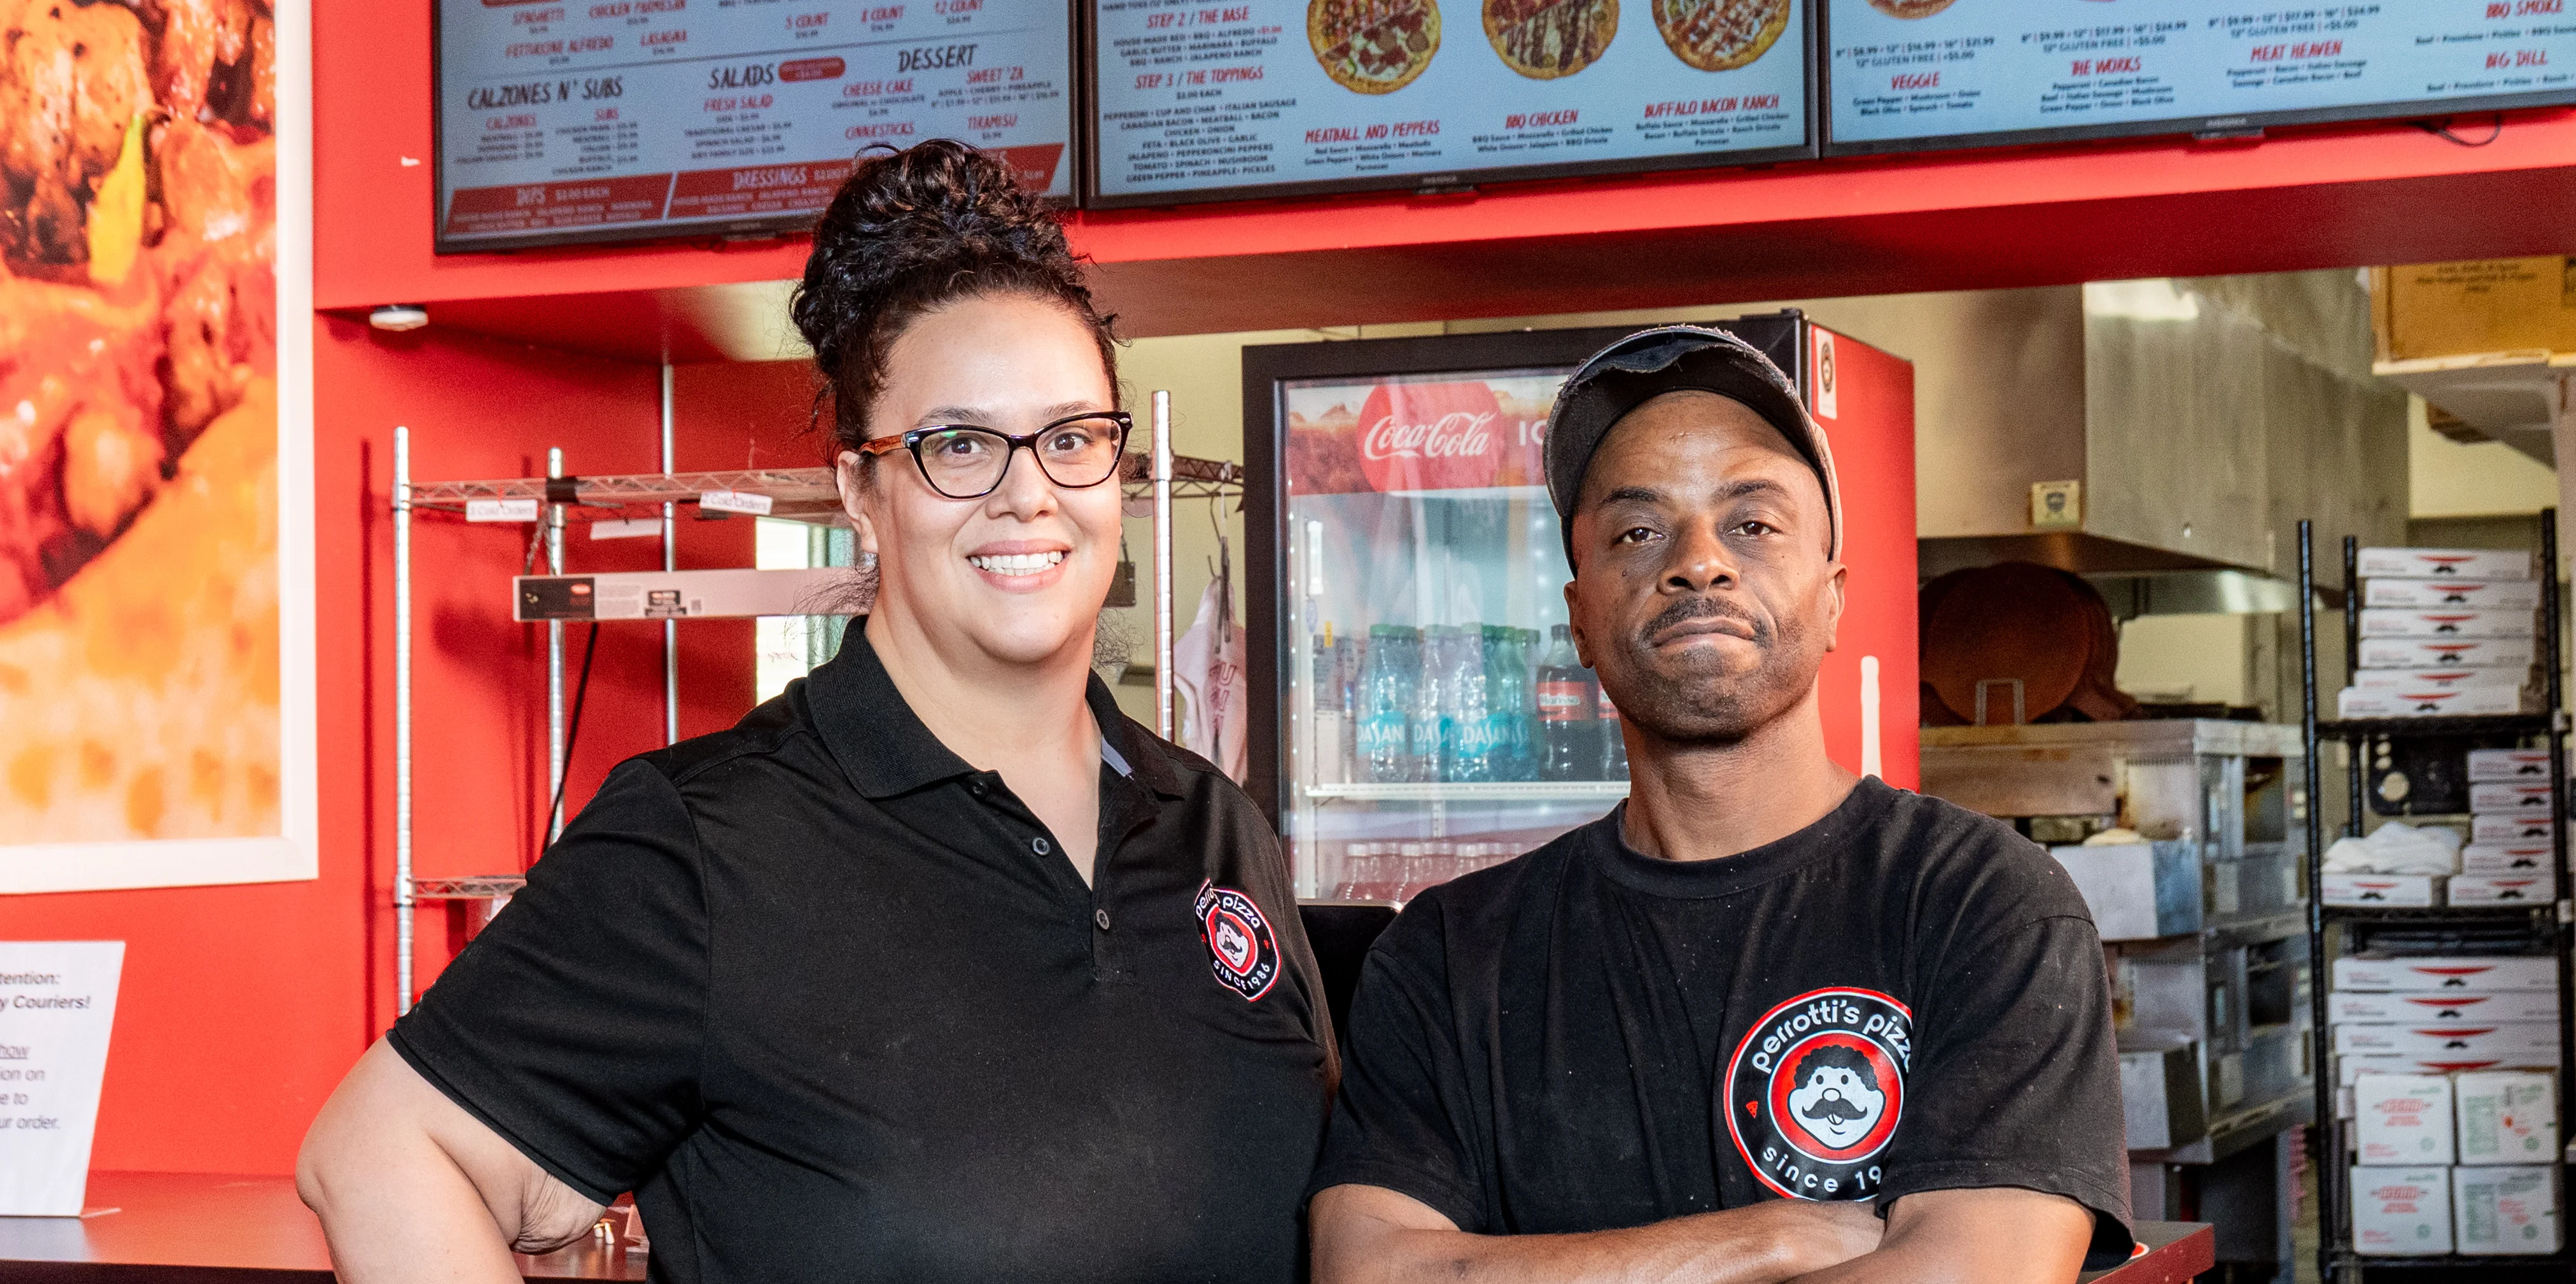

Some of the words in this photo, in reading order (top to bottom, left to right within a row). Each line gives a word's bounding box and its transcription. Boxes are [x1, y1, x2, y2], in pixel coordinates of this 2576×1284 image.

[870, 4, 905, 23] COUNT
[934, 1, 946, 15] 12
[949, 0, 984, 13] COUNT
[1102, 3, 1126, 11] HAND
[2285, 10, 2316, 21] $17.99
[2486, 2, 2512, 20] BBQ
[2516, 0, 2563, 16] SMOKE
[795, 11, 829, 29] COUNT
[1147, 12, 1175, 28] STEP
[1178, 11, 1186, 27] 2
[1200, 9, 1219, 25] THE
[1222, 6, 1249, 22] BASE
[640, 30, 687, 47] LASAGNA
[1114, 37, 1140, 46] HOUSE
[1144, 35, 1167, 44] MADE
[1170, 34, 1186, 42] RED
[1194, 32, 1210, 40] BBQ
[1218, 28, 1254, 38] ALFREDO
[2095, 26, 2124, 37] $17.99
[2247, 25, 2289, 38] GLUTEN
[2291, 22, 2315, 33] FREE
[1120, 48, 1148, 57] GARLIC
[1151, 45, 1182, 54] BUTTER
[1189, 41, 1233, 51] MARINARA
[1240, 37, 1277, 47] BUFFALO
[1966, 36, 1994, 47] $21.99
[2059, 41, 2098, 52] GLUTEN
[2101, 38, 2124, 48] FREE
[2415, 36, 2433, 45] Beef
[897, 43, 979, 73] DESSERT
[1130, 59, 1147, 67] BBQ
[1154, 56, 1182, 64] RANCH
[1189, 52, 1231, 62] JALAPENO
[1233, 49, 1262, 58] RANCH
[1871, 56, 1909, 67] GLUTEN
[1912, 53, 1935, 63] FREE
[2250, 43, 2288, 62] MEAT
[2290, 39, 2344, 60] HEAVEN
[2486, 52, 2510, 69] BIG
[2516, 48, 2548, 67] DILL
[967, 67, 1004, 85] SWEET
[2071, 60, 2092, 77] THE
[2095, 56, 2141, 74] WORKS
[708, 64, 775, 90] SALADS
[1135, 74, 1162, 90] STEP
[1166, 73, 1173, 87] 3
[1186, 70, 1205, 85] THE
[1211, 65, 1264, 83] TOPPINGS
[1891, 71, 1939, 90] VEGGIE
[467, 81, 552, 111] CALZONES
[582, 75, 623, 100] SUBS
[843, 81, 883, 98] CHEESE
[885, 77, 914, 94] CAKE
[1200, 89, 1222, 97] EACH
[2426, 84, 2444, 92] Beef
[703, 97, 736, 113] FRESH
[739, 94, 774, 110] SALAD
[1103, 111, 1148, 121] PEPPERONI
[1156, 109, 1172, 118] CUP
[1194, 106, 1215, 115] CHAR
[1226, 102, 1257, 111] ITALIAN
[1259, 98, 1296, 108] SAUSAGE
[1644, 100, 1698, 118] BUFFALO
[1701, 97, 1738, 115] BACON
[1742, 94, 1779, 111] RANCH
[486, 113, 537, 131] CALZONES
[594, 107, 620, 122] SUBS
[967, 113, 1019, 130] TIRAMISU
[1121, 119, 1163, 130] CANADIAN
[1166, 118, 1193, 127] BACON
[1201, 114, 1243, 123] MEATBALL
[1251, 111, 1279, 120] BACON
[1506, 113, 1526, 129] BBQ
[1529, 109, 1579, 127] CHICKEN
[1736, 114, 1759, 123] Grilled
[1761, 111, 1789, 120] Chicken
[1142, 141, 1162, 150] FETA
[1170, 138, 1194, 146] BLACK
[1198, 136, 1220, 145] OLIVE
[1228, 133, 1257, 143] GARLIC
[1165, 129, 1200, 138] CHICKEN
[1208, 126, 1235, 134] ONION
[1305, 127, 1360, 144] MEATBALL
[1364, 123, 1388, 140] AND
[1392, 120, 1440, 138] PEPPERS
[1128, 152, 1169, 162] JALAPENO
[1177, 146, 1235, 157] PEPPERONCINI
[1238, 143, 1273, 153] PEPPERS
[1134, 162, 1167, 171] TOMATO
[1175, 159, 1210, 168] SPINACH
[1218, 154, 1268, 165] MUSHROOM
[733, 167, 807, 191] DRESSINGS
[1126, 174, 1154, 183] GREEN
[1156, 172, 1186, 181] PEPPER
[1193, 167, 1236, 178] PINEAPPLE
[1242, 164, 1275, 174] PICKLES
[516, 186, 547, 207] DIPS
[1364, 411, 1497, 461] Coca-Cola
[711, 493, 732, 507] Cold
[735, 497, 767, 512] Orders
[1222, 894, 1261, 929] pizza
[1213, 960, 1247, 991] SINCE
[1247, 962, 1270, 990] 1986
[13, 994, 91, 1010] Couriers!
[1751, 999, 1861, 1075] perrotti's
[25, 1069, 46, 1082] on
[13, 1092, 29, 1106] to
[17, 1114, 60, 1130] order.
[1762, 1146, 1838, 1192] since
